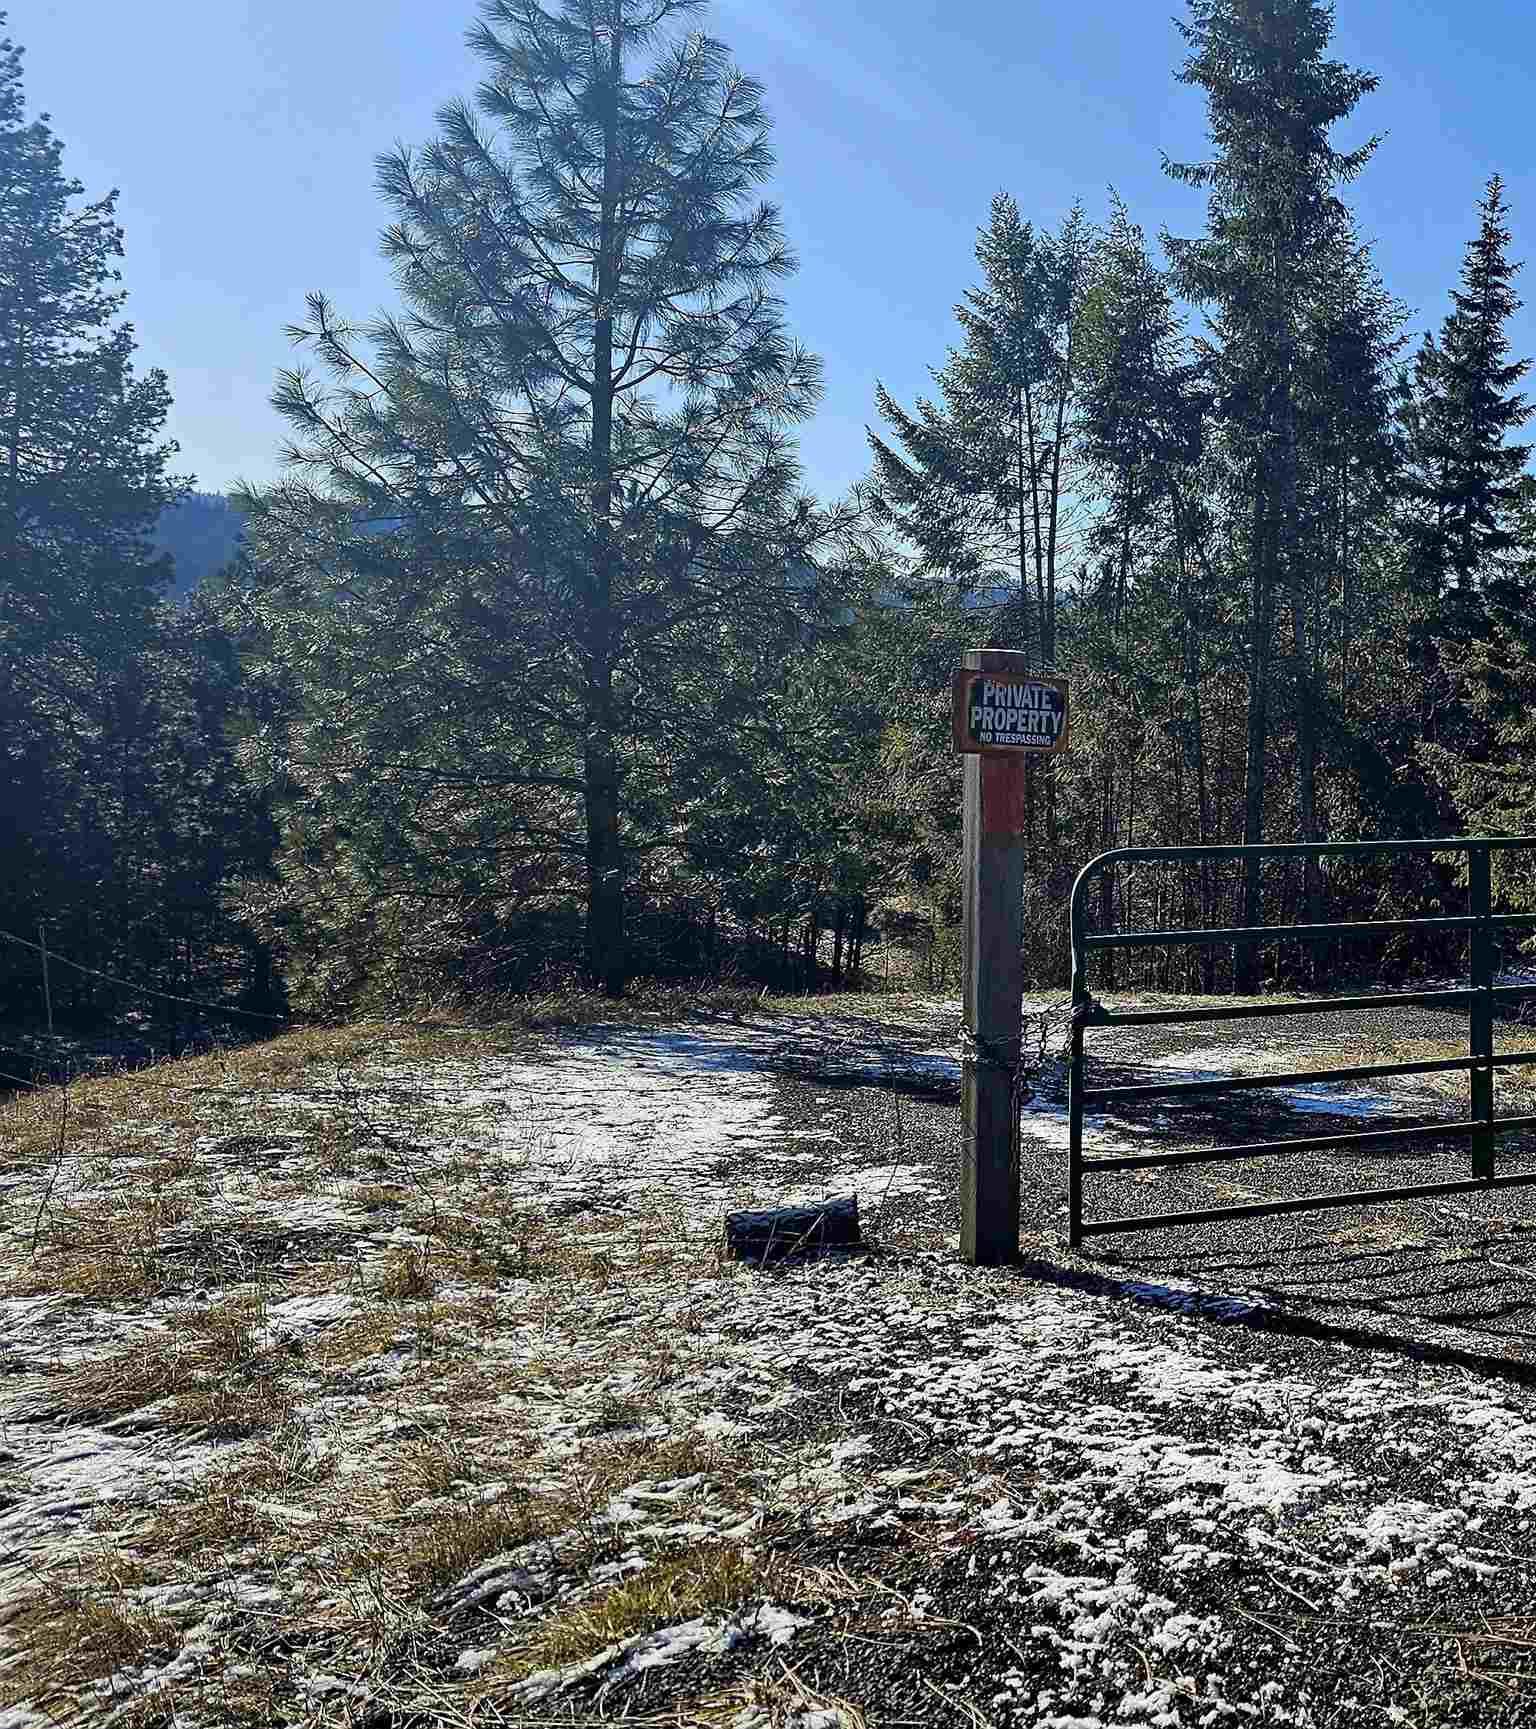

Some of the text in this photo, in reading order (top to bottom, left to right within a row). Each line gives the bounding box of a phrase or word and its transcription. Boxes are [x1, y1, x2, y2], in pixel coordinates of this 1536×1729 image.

[983, 680, 1053, 709] PRIVATE
[970, 706, 1062, 733] PROPERTY
[980, 731, 1051, 746] NO TRESPASSING
